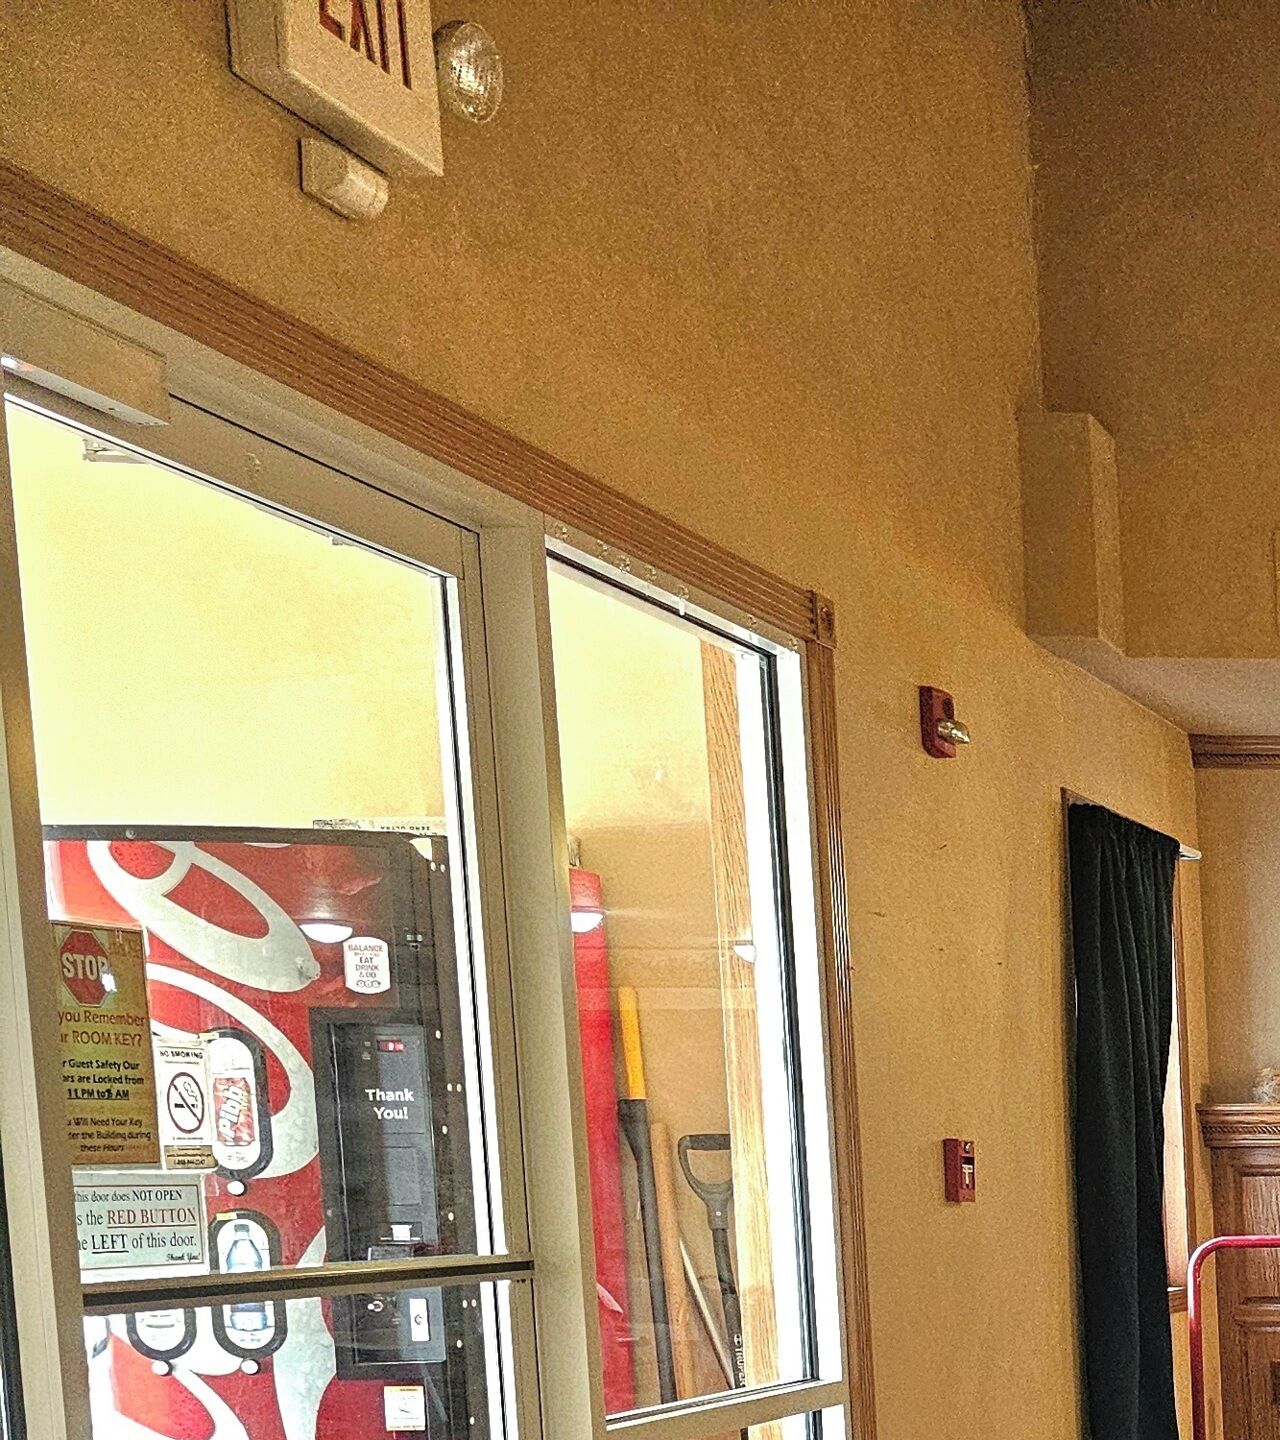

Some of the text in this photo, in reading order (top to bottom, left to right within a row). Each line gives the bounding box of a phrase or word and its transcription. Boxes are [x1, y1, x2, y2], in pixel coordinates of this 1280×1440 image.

[348, 944, 383, 952] BALANCE
[61, 952, 108, 981] STOP
[58, 1010, 145, 1027] you Remember
[72, 1031, 111, 1046] ROOM
[113, 1033, 142, 1047] KEY?
[171, 1051, 203, 1059] SMOKING
[68, 1059, 94, 1069] Guest
[96, 1060, 121, 1072] Safety
[123, 1061, 140, 1070] Our
[77, 1075, 91, 1084] are
[93, 1074, 123, 1085] Locked
[125, 1075, 145, 1085] from
[81, 1088, 95, 1098] PM
[115, 1089, 130, 1099] AM
[365, 1088, 415, 1101] Thank
[373, 1106, 408, 1119] You!
[90, 1117, 110, 1127] Need
[111, 1117, 128, 1127] Your
[96, 1130, 127, 1141] Building
[91, 1190, 109, 1202] door
[112, 1190, 130, 1202] does
[132, 1190, 152, 1202] NOT
[155, 1190, 182, 1201] OPEN
[86, 1209, 103, 1226] the
[107, 1209, 136, 1225] RED
[141, 1207, 197, 1224] BUTTON
[92, 1234, 128, 1251] LEFT
[132, 1233, 143, 1249] of
[147, 1232, 166, 1248] this
[170, 1231, 197, 1247] door.
